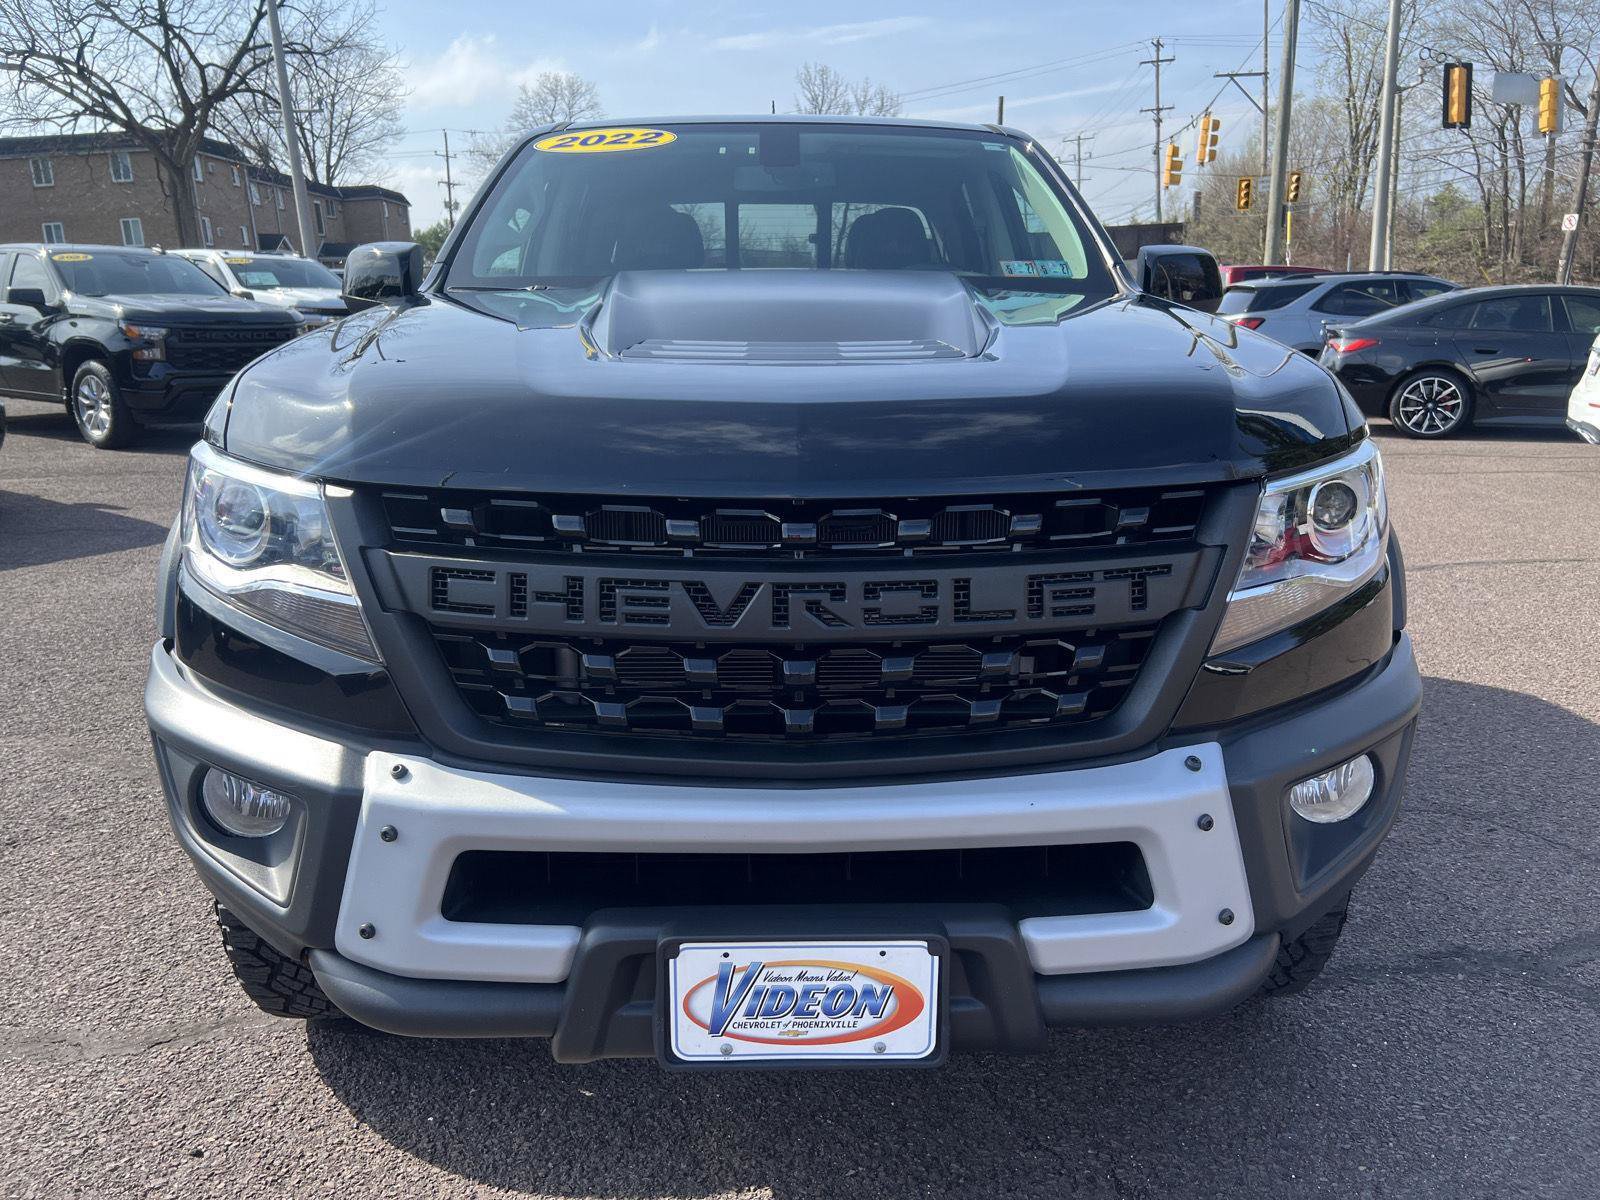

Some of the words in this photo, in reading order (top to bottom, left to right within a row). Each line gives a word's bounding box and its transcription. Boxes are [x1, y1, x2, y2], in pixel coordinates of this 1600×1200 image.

[548, 132, 664, 149] 2022
[428, 563, 1173, 630] CHEVROLET
[763, 970, 792, 982] Videon
[794, 970, 824, 982] Means
[826, 970, 858, 982] Value!
[708, 962, 893, 1037] VIDEON
[732, 1021, 782, 1029] CHEVROLET
[782, 1021, 792, 1029] of
[792, 1020, 859, 1029] PHOENIXVILLE
